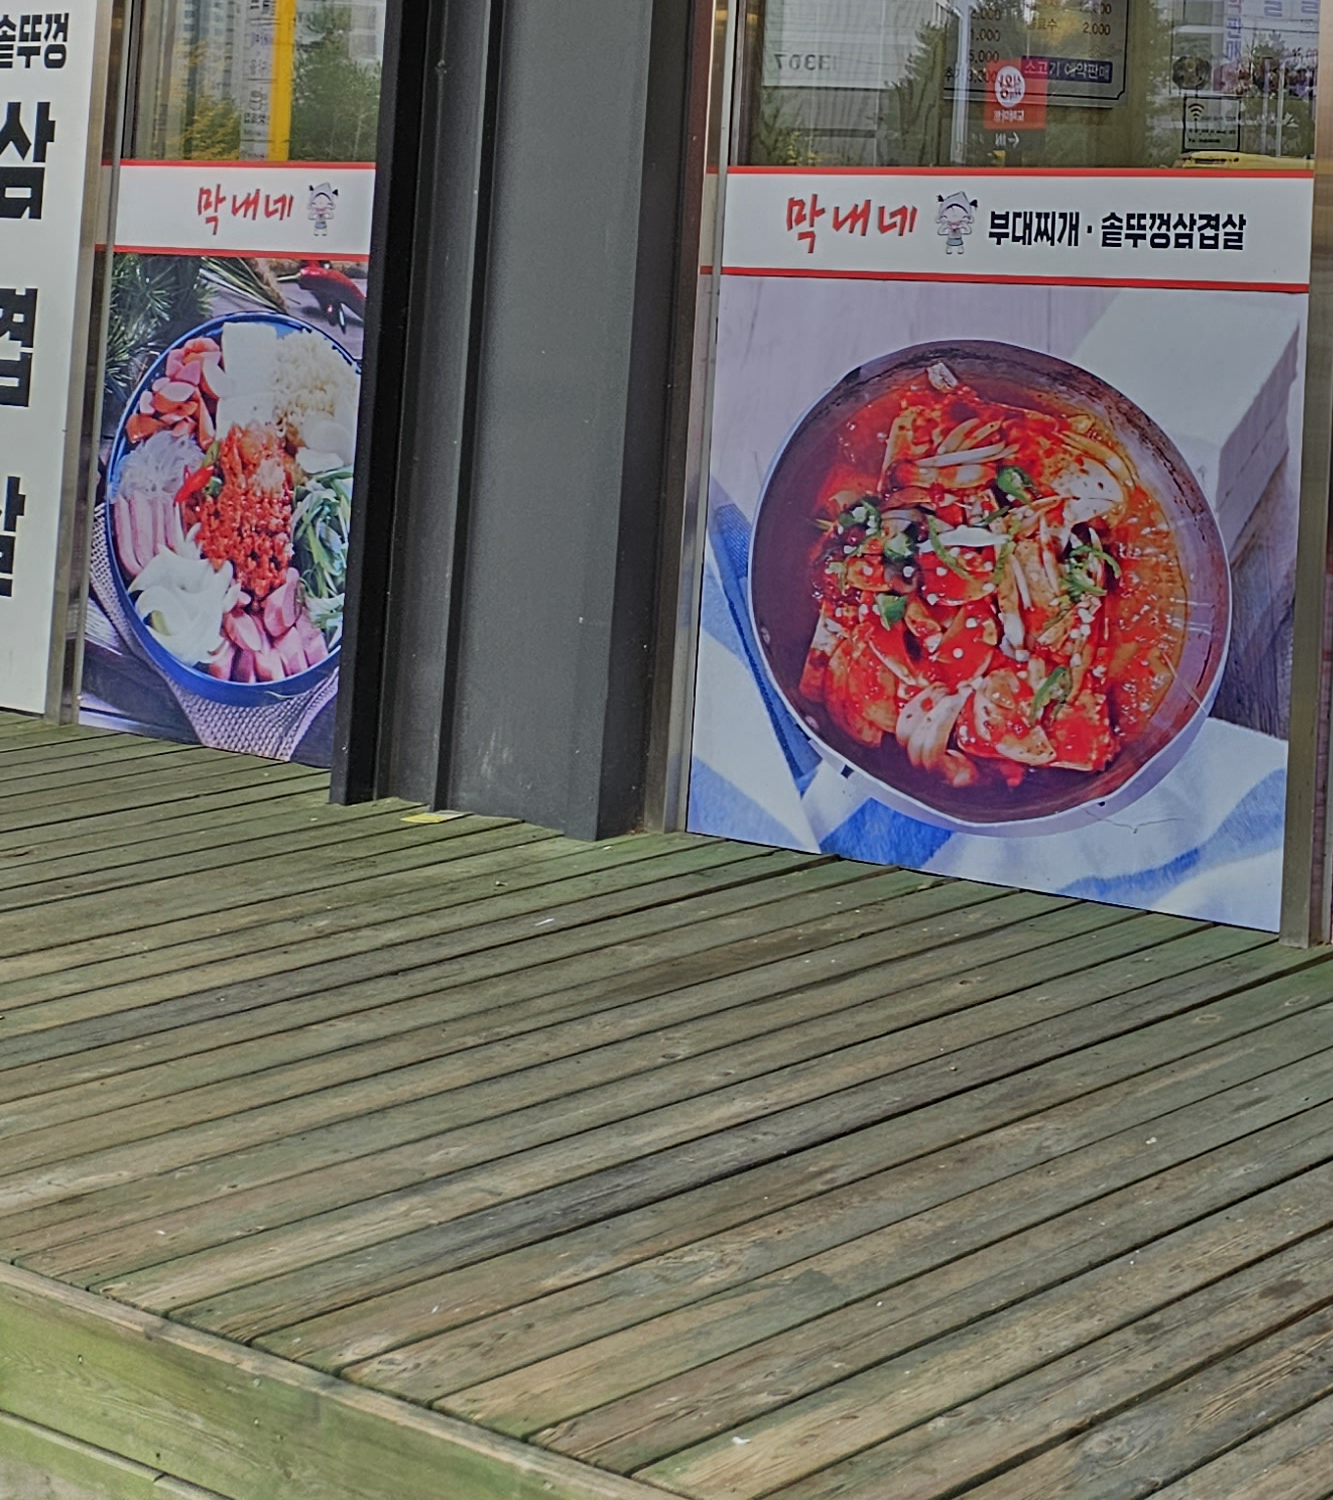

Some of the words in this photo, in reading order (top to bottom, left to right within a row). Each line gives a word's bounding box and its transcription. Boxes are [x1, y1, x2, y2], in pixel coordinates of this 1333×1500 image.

[1024, 59, 1059, 77] 소고기
[197, 183, 293, 235] 막내네
[786, 193, 918, 254] 막내네
[988, 210, 1080, 248] 부대찌개
[1100, 211, 1248, 251] 솥뚜껑삼겹살
